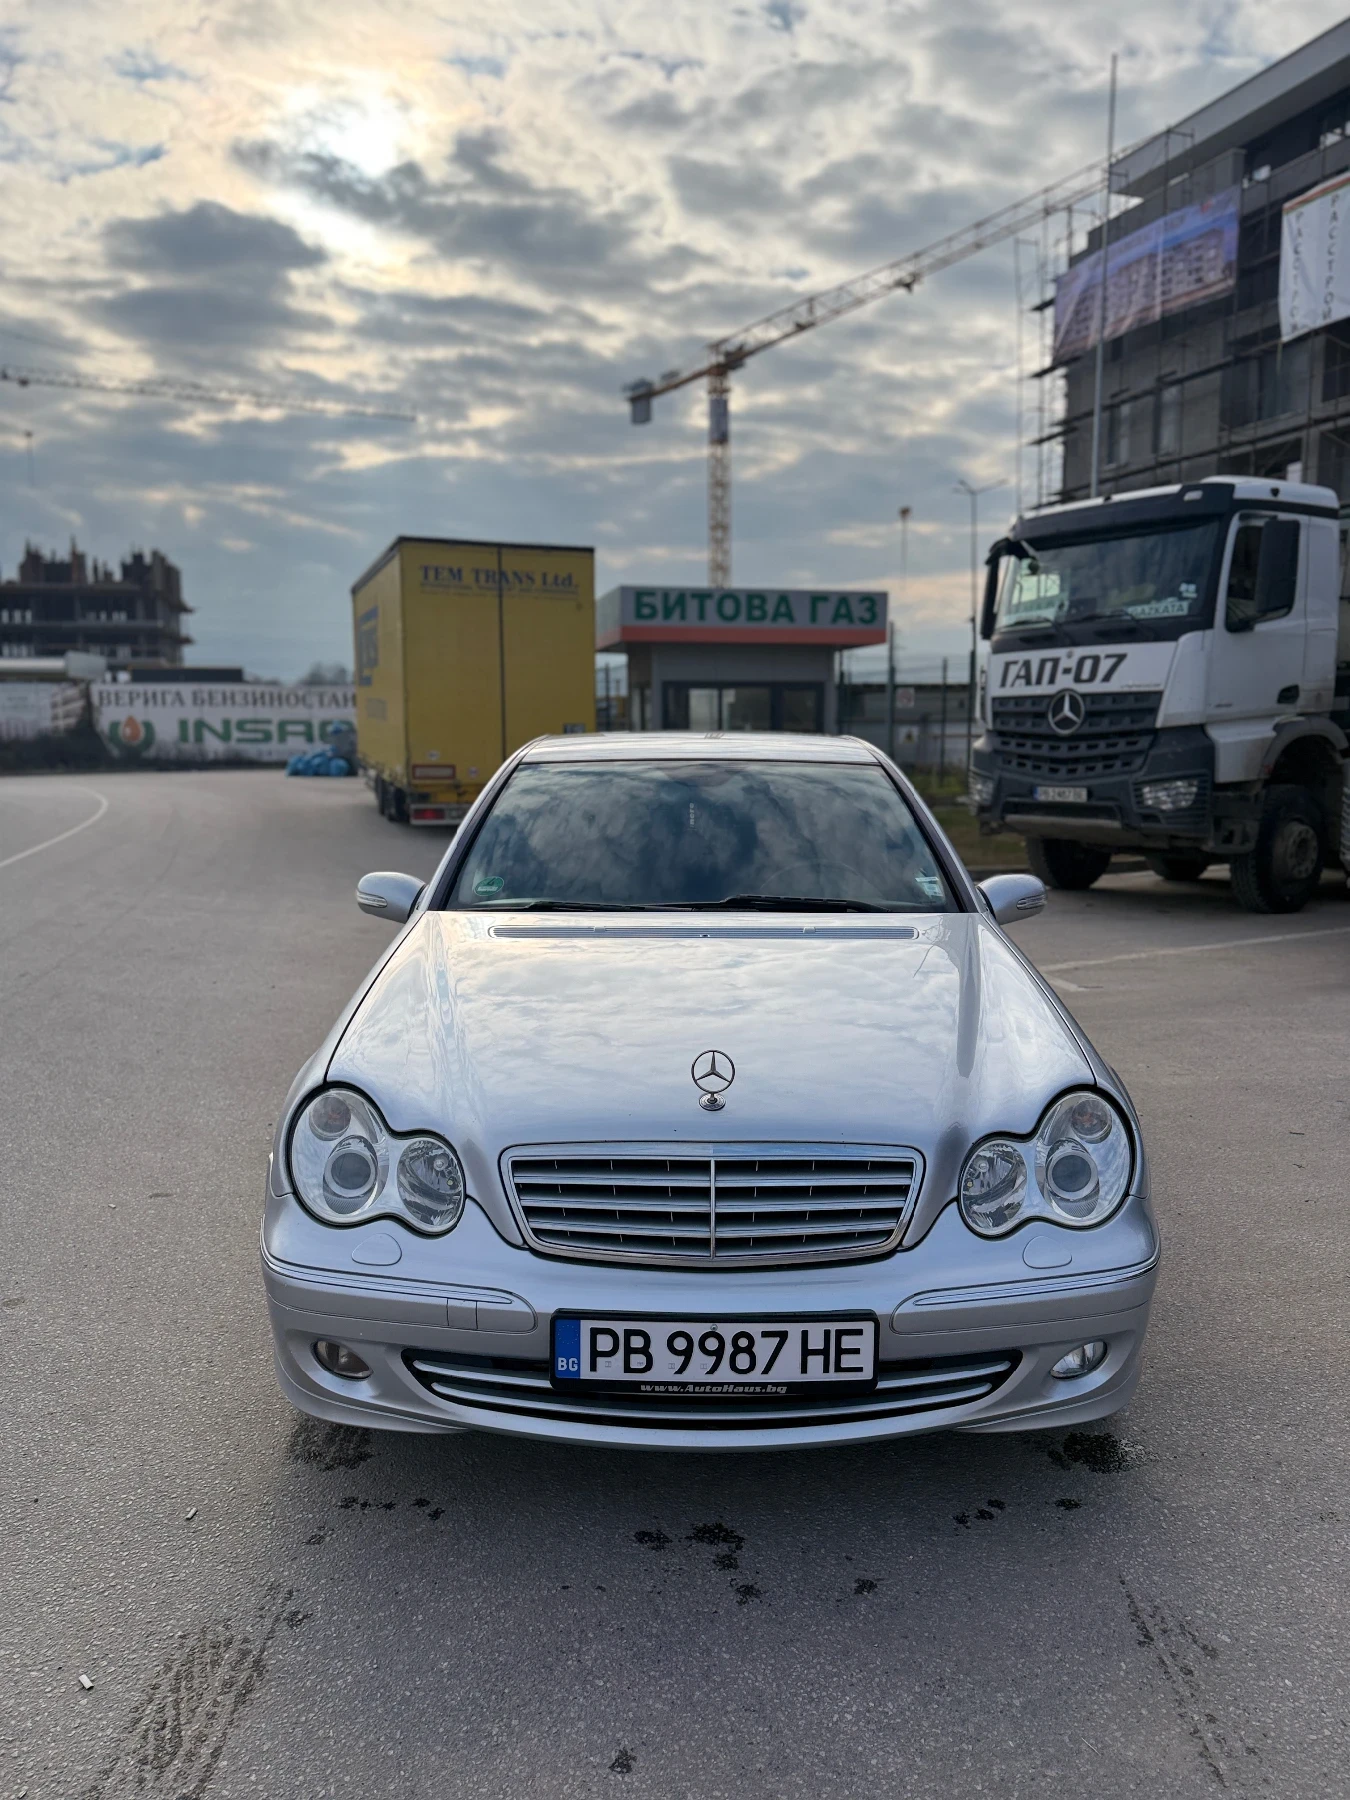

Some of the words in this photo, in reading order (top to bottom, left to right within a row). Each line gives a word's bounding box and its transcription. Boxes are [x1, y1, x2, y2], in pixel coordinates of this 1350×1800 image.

[419, 564, 464, 583] TEM
[471, 567, 535, 585] TRANS
[634, 590, 795, 624] БИТОВА
[809, 594, 879, 625] ГАЗ
[1000, 653, 1127, 688] ГАП-07
[98, 689, 186, 708] ВЕРИГА
[589, 1327, 654, 1374] PB
[666, 1330, 789, 1375] 9987
[800, 1328, 864, 1374] HE
[557, 1357, 579, 1371] BG
[640, 1383, 788, 1394] www.AutoHaus.bg
